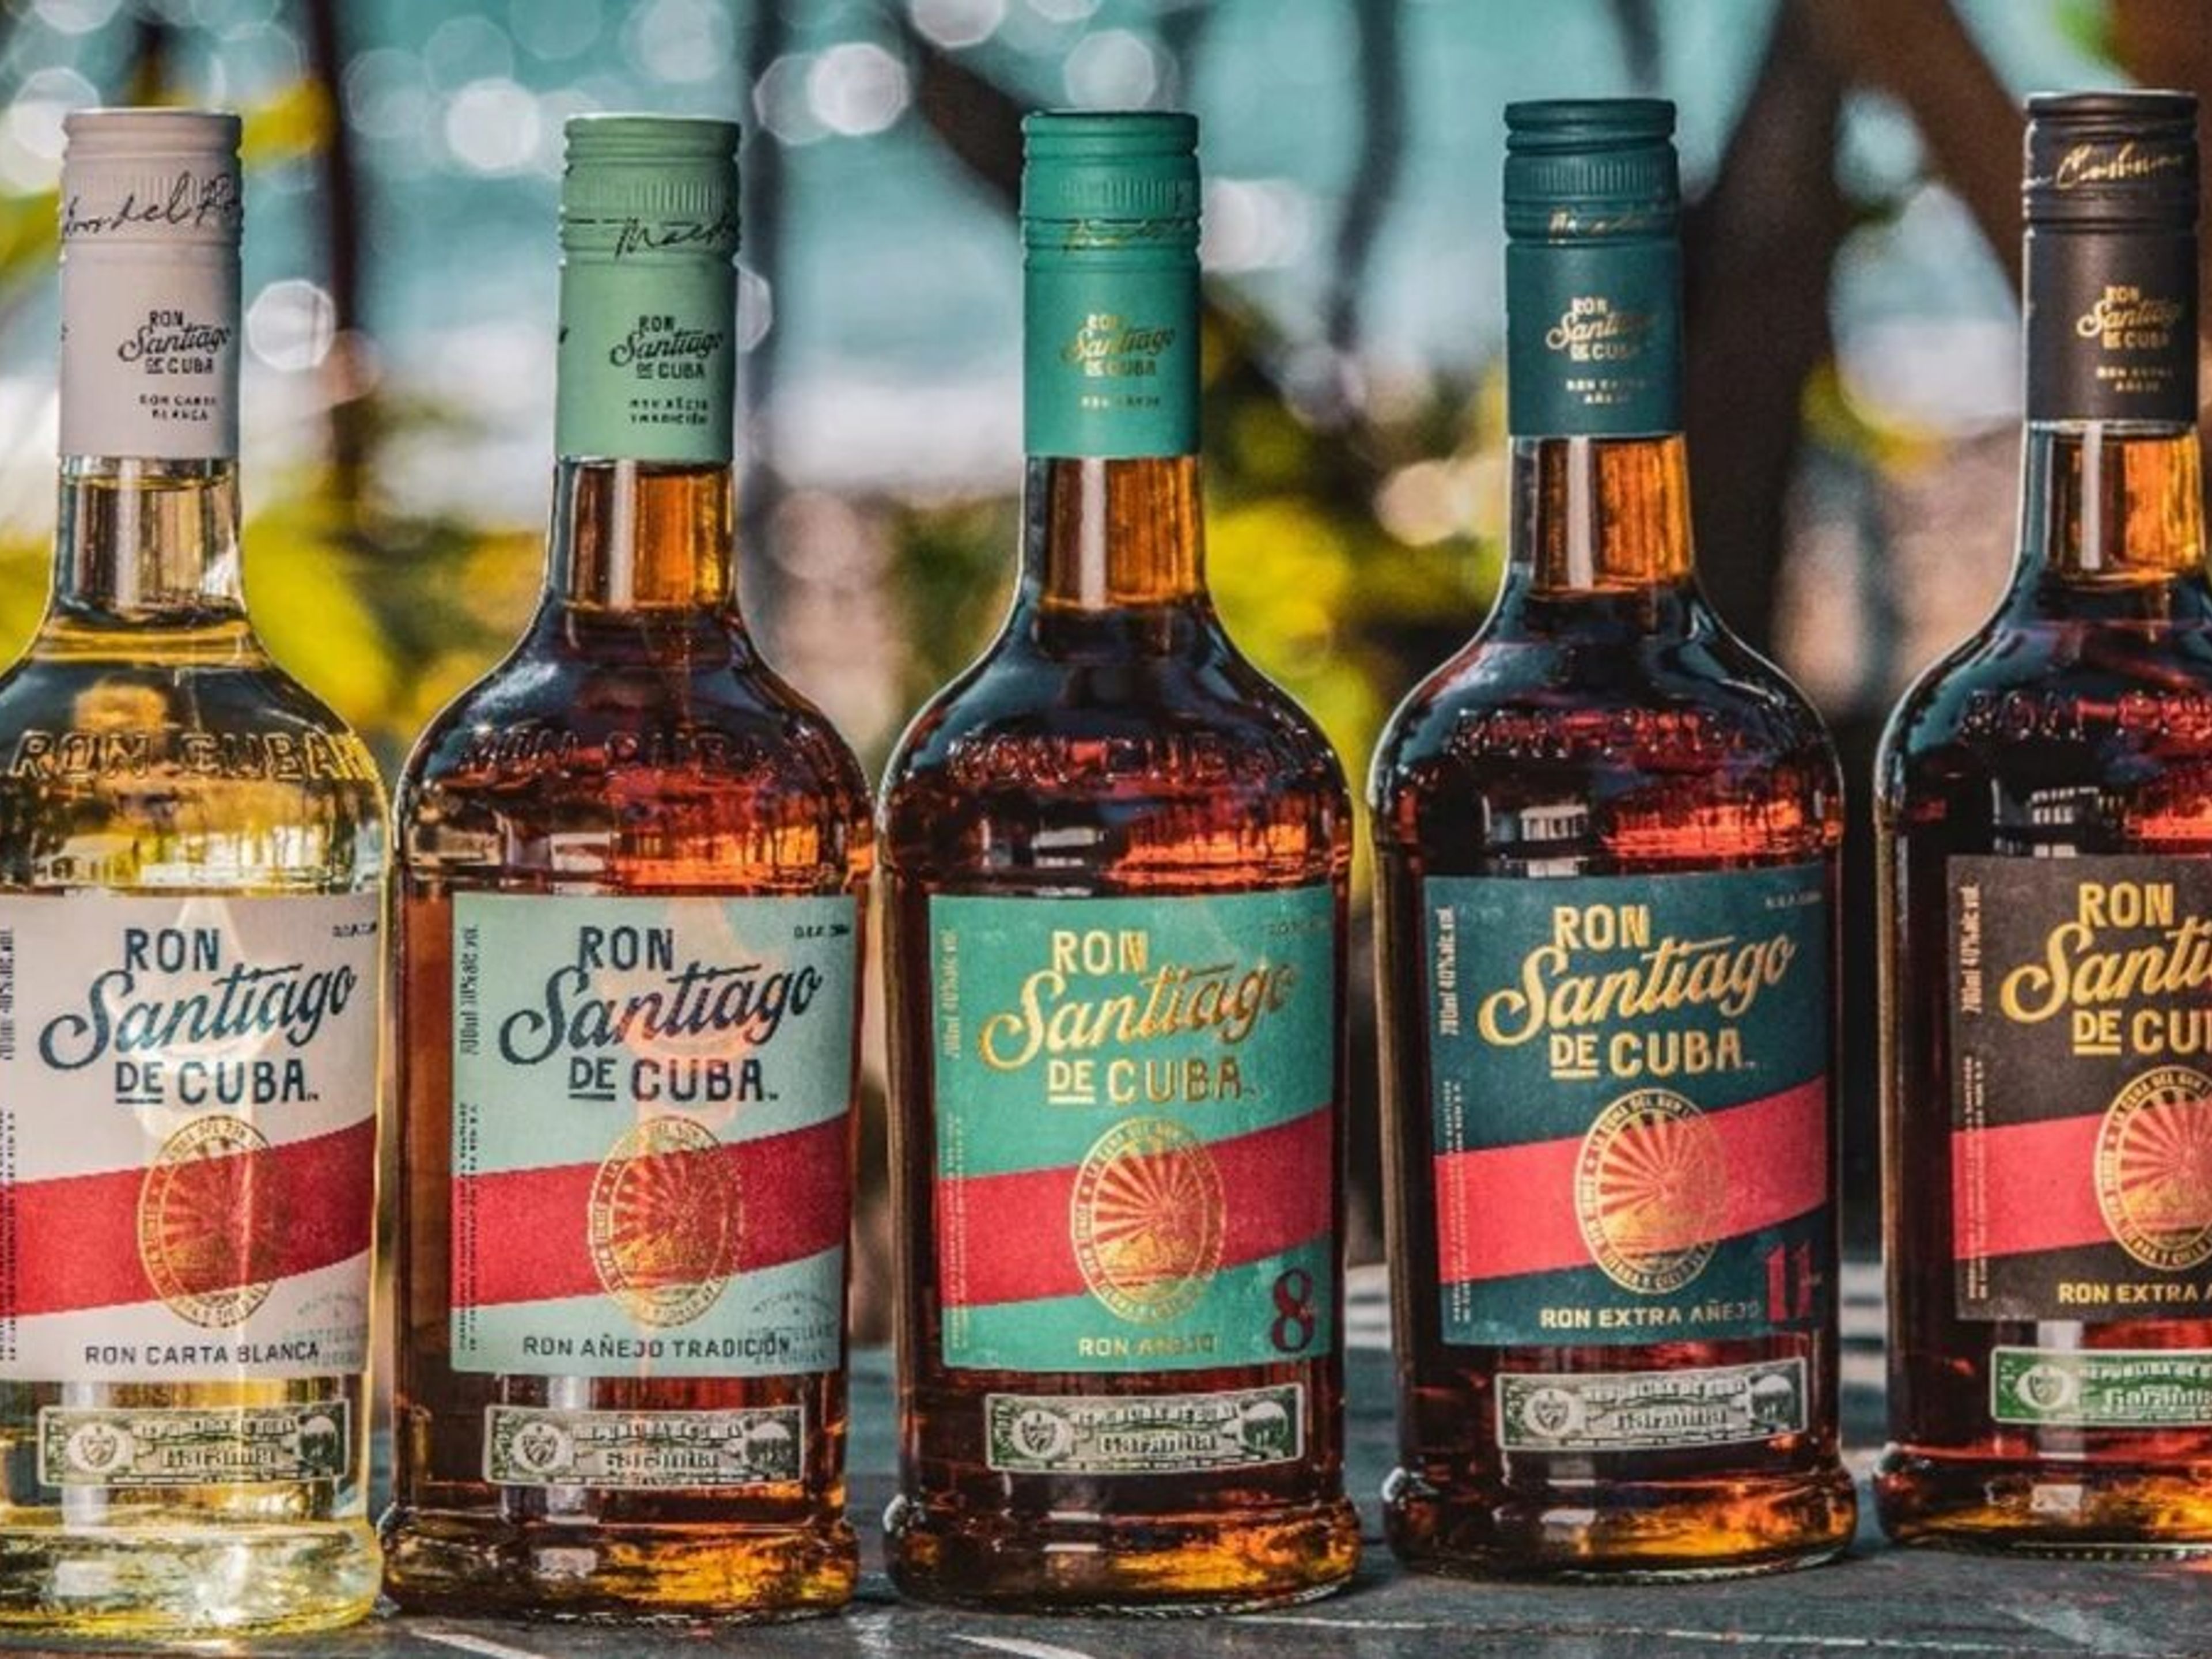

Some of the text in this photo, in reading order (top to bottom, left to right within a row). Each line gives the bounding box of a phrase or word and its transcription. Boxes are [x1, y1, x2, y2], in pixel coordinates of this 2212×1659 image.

[1571, 297, 1608, 315] RON
[2105, 286, 2139, 303] RON
[149, 310, 183, 328] RON
[638, 316, 675, 334] RON
[1546, 311, 1652, 349] Santi
[118, 323, 231, 362] Santiago
[610, 329, 723, 367] Santiago
[146, 357, 214, 374] DE CUBA
[657, 363, 706, 379] CUBA
[8, 729, 151, 779] RON
[1554, 904, 1649, 950] RON
[2079, 882, 2175, 927] RON
[125, 928, 219, 973] RON
[579, 926, 674, 971] RON
[1053, 930, 1149, 975] RON
[1478, 934, 1796, 1047] Santiago
[38, 963, 357, 1070] Santiago
[499, 961, 823, 1066] Santiago
[979, 963, 1294, 1070] Santiago
[2074, 1009, 2212, 1054] DE CU
[1550, 1028, 1743, 1079] DE CUBA
[115, 1059, 306, 1104] DE CUBA
[569, 1058, 763, 1102] DE CUBA
[1049, 1057, 1242, 1104] DE CUBA
[1767, 1241, 1813, 1323] 11
[2058, 1282, 2198, 1304] RON EXTRA
[1271, 1267, 1315, 1353] 8
[1540, 1307, 1593, 1329] RON
[1599, 1305, 1683, 1328] EXTRA
[85, 1340, 320, 1365] RON CARTA BLANCA
[523, 1332, 790, 1359] RON AÑEJO TRADICIÓN
[1078, 1337, 1129, 1357] RON
